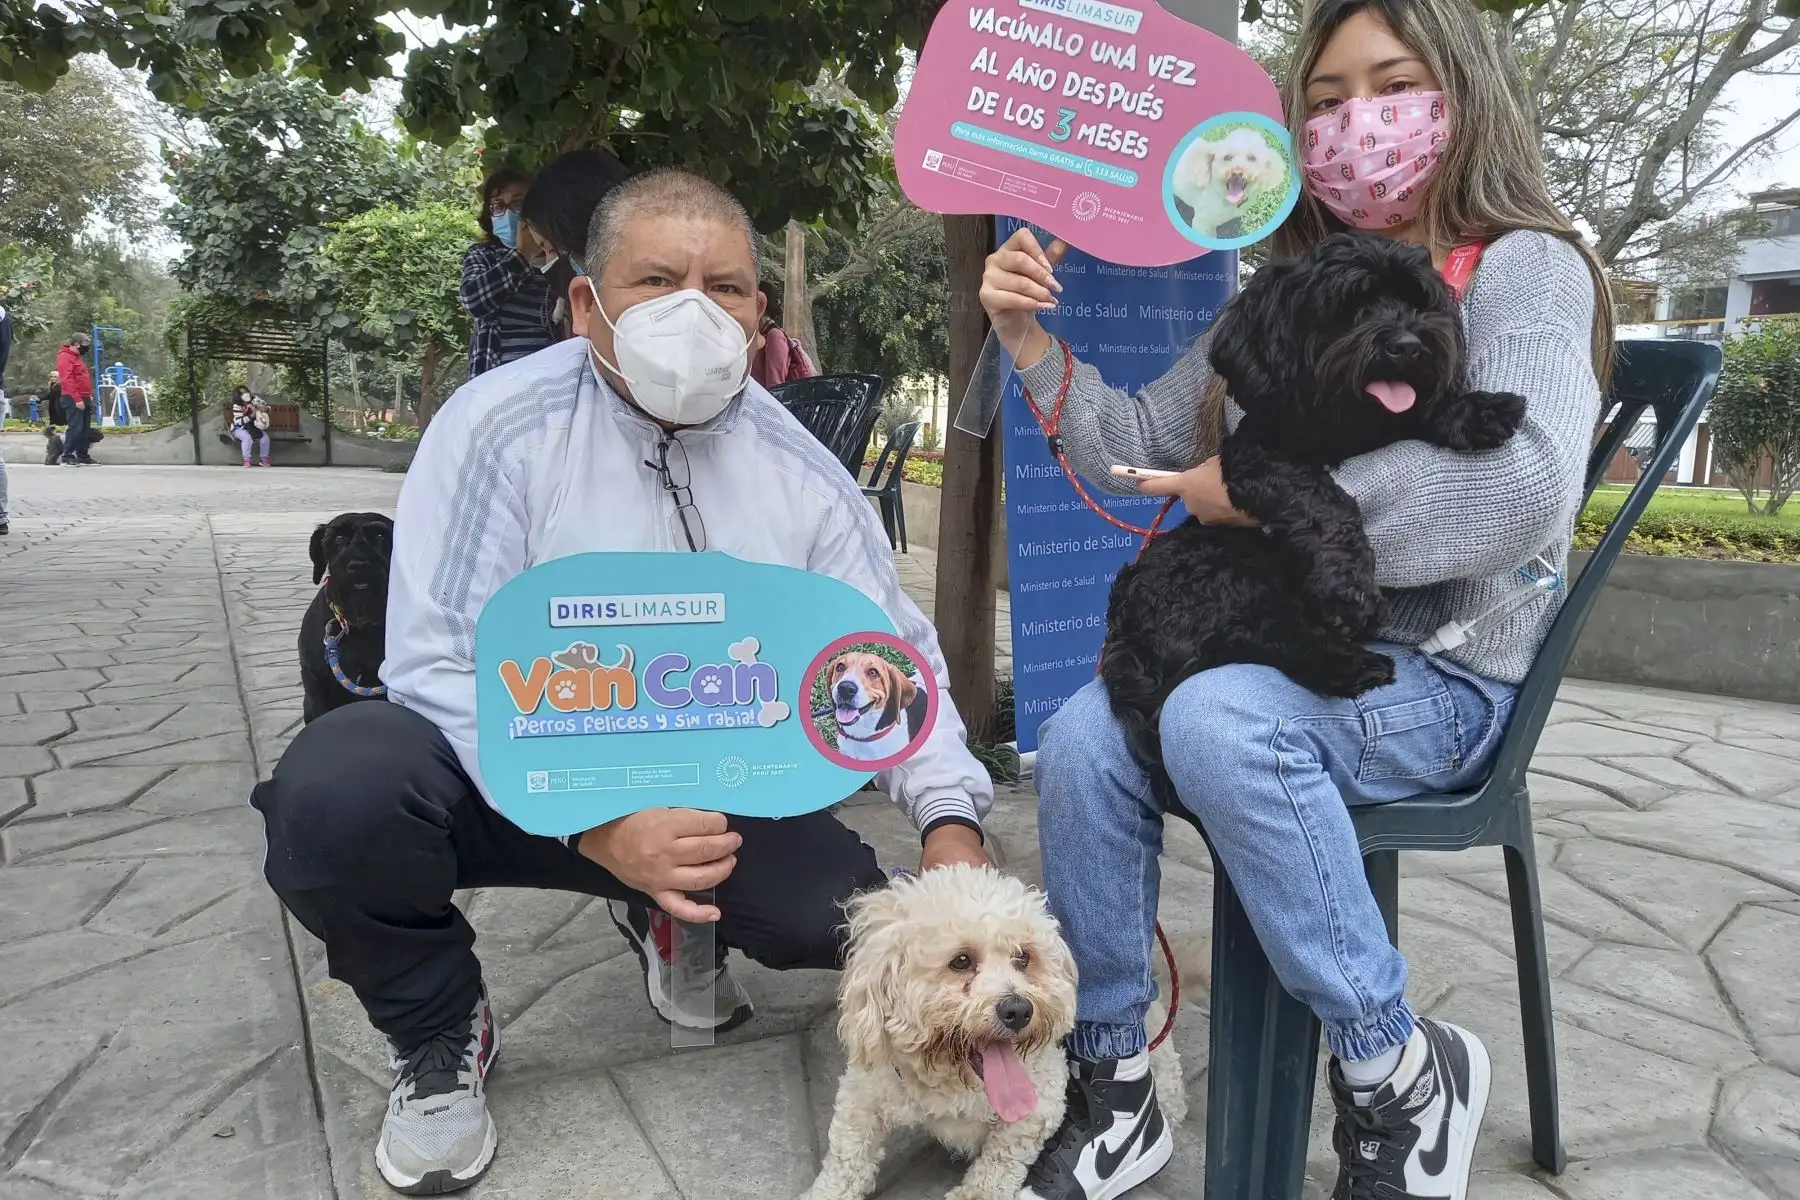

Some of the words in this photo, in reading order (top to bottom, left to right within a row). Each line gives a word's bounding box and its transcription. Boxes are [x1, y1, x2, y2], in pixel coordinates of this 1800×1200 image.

[1025, 0, 1136, 28] ISLIMASUR
[969, 7, 1083, 57] VACÚNALO
[1090, 39, 1136, 71] UNA
[1148, 53, 1197, 86] VEZ
[970, 46, 999, 76] AL
[1006, 56, 1057, 91] AÑO
[1062, 71, 1164, 120] DESPUÉS
[967, 86, 1000, 115] DE
[1003, 97, 1045, 130] LOS
[1048, 106, 1077, 142] 3
[1077, 122, 1149, 159] MESES
[954, 126, 970, 137] Para
[971, 131, 986, 141] más
[986, 135, 1028, 153] información
[1028, 147, 1048, 159] llama
[1049, 153, 1074, 167] GRATIS
[1075, 160, 1083, 169] al
[1095, 166, 1109, 176] 113
[1110, 170, 1134, 184] SALUD
[1064, 263, 1086, 274] Salud
[1096, 265, 1136, 277] Ministerio
[1138, 267, 1147, 277] de
[1149, 268, 1168, 279] Salud
[1174, 270, 1214, 281] Ministerio
[1215, 272, 1224, 281] de
[1076, 302, 1092, 317] de
[1095, 302, 1128, 318] Salud
[1140, 304, 1194, 320] Ministerio
[1197, 307, 1213, 321] de
[1068, 343, 1088, 353] alud
[1099, 343, 1137, 354] Ministerio
[1138, 344, 1148, 354] de
[1149, 344, 1170, 354] Salud
[1017, 503, 1058, 515] Ministerio
[1059, 501, 1070, 512] de
[1071, 500, 1091, 511] Salu
[1103, 497, 1140, 509] Ministerio
[1018, 538, 1080, 558] Ministerio
[1083, 536, 1099, 551] de
[1101, 533, 1132, 549] Salud
[1020, 581, 1060, 593] Ministerio
[1061, 578, 1072, 587] de
[1074, 575, 1095, 586] Salud
[1021, 616, 1083, 637] Ministerio
[1086, 613, 1100, 627] de
[1023, 659, 1063, 674] Ministerio
[1064, 656, 1075, 667] de
[1077, 652, 1098, 665] Salud
[498, 656, 637, 714] Van
[642, 652, 779, 709] Can
[508, 716, 577, 740] ¡Perros
[583, 714, 649, 734] felices
[656, 714, 668, 730] y
[707, 710, 756, 727] rabia!
[1362, 1141, 1378, 1154] 23
